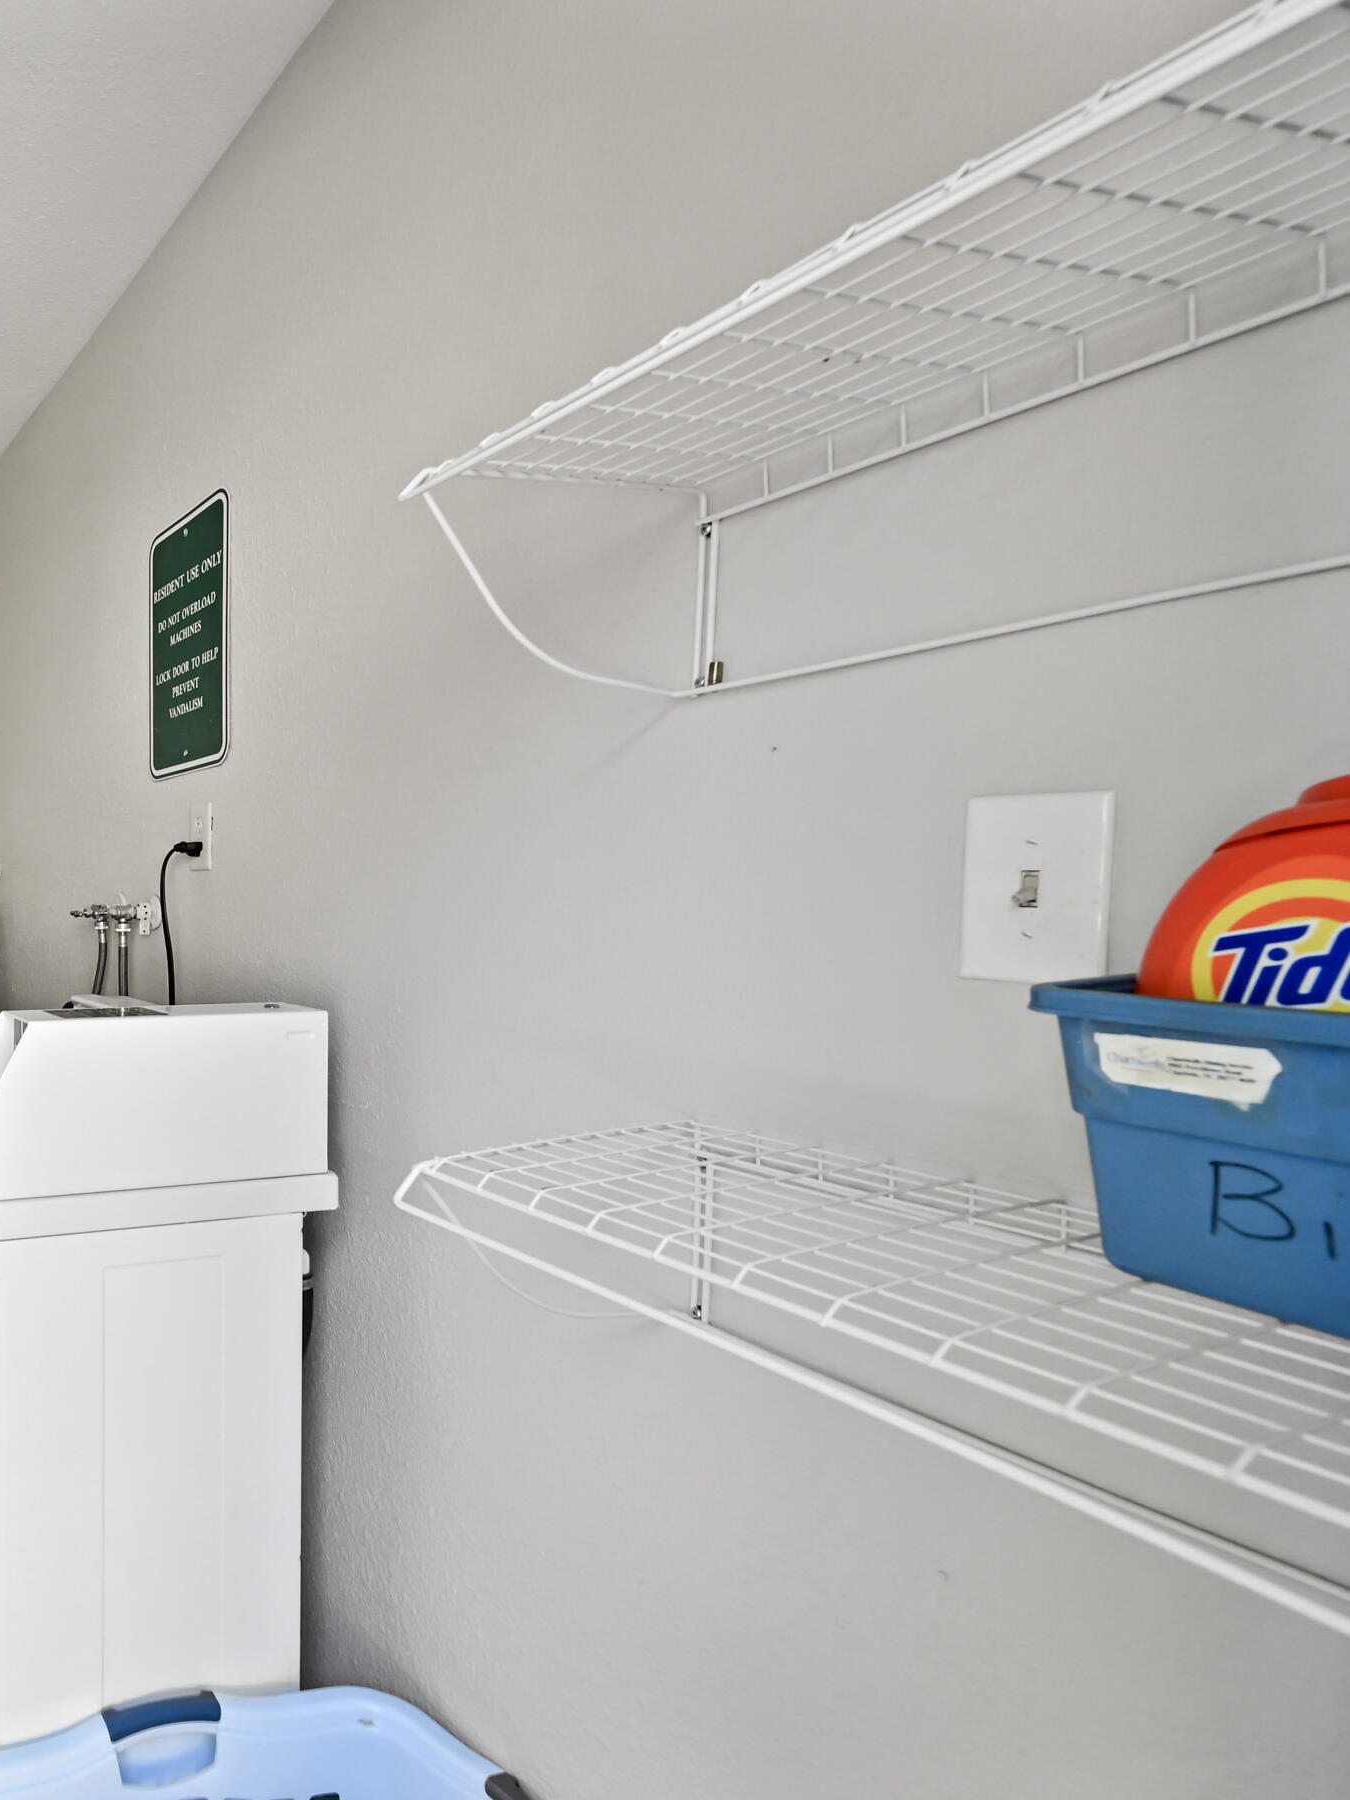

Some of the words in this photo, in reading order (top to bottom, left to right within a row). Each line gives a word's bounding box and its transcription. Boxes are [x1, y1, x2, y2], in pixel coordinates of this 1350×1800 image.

[153, 573, 185, 604] RESIDENT
[186, 564, 200, 583] USE
[201, 549, 222, 574] ONLY
[158, 620, 167, 634] DO
[167, 611, 181, 628] NOT
[181, 591, 216, 620] OVERLOAD
[170, 620, 202, 646] MACHINES
[156, 669, 171, 686] LOCK
[172, 661, 190, 678] DOOR
[191, 655, 201, 670] TO
[201, 646, 219, 665] HELP
[169, 696, 204, 718] VANDALISM
[172, 676, 200, 698] PREVENT
[1208, 919, 1350, 1008] Tid
